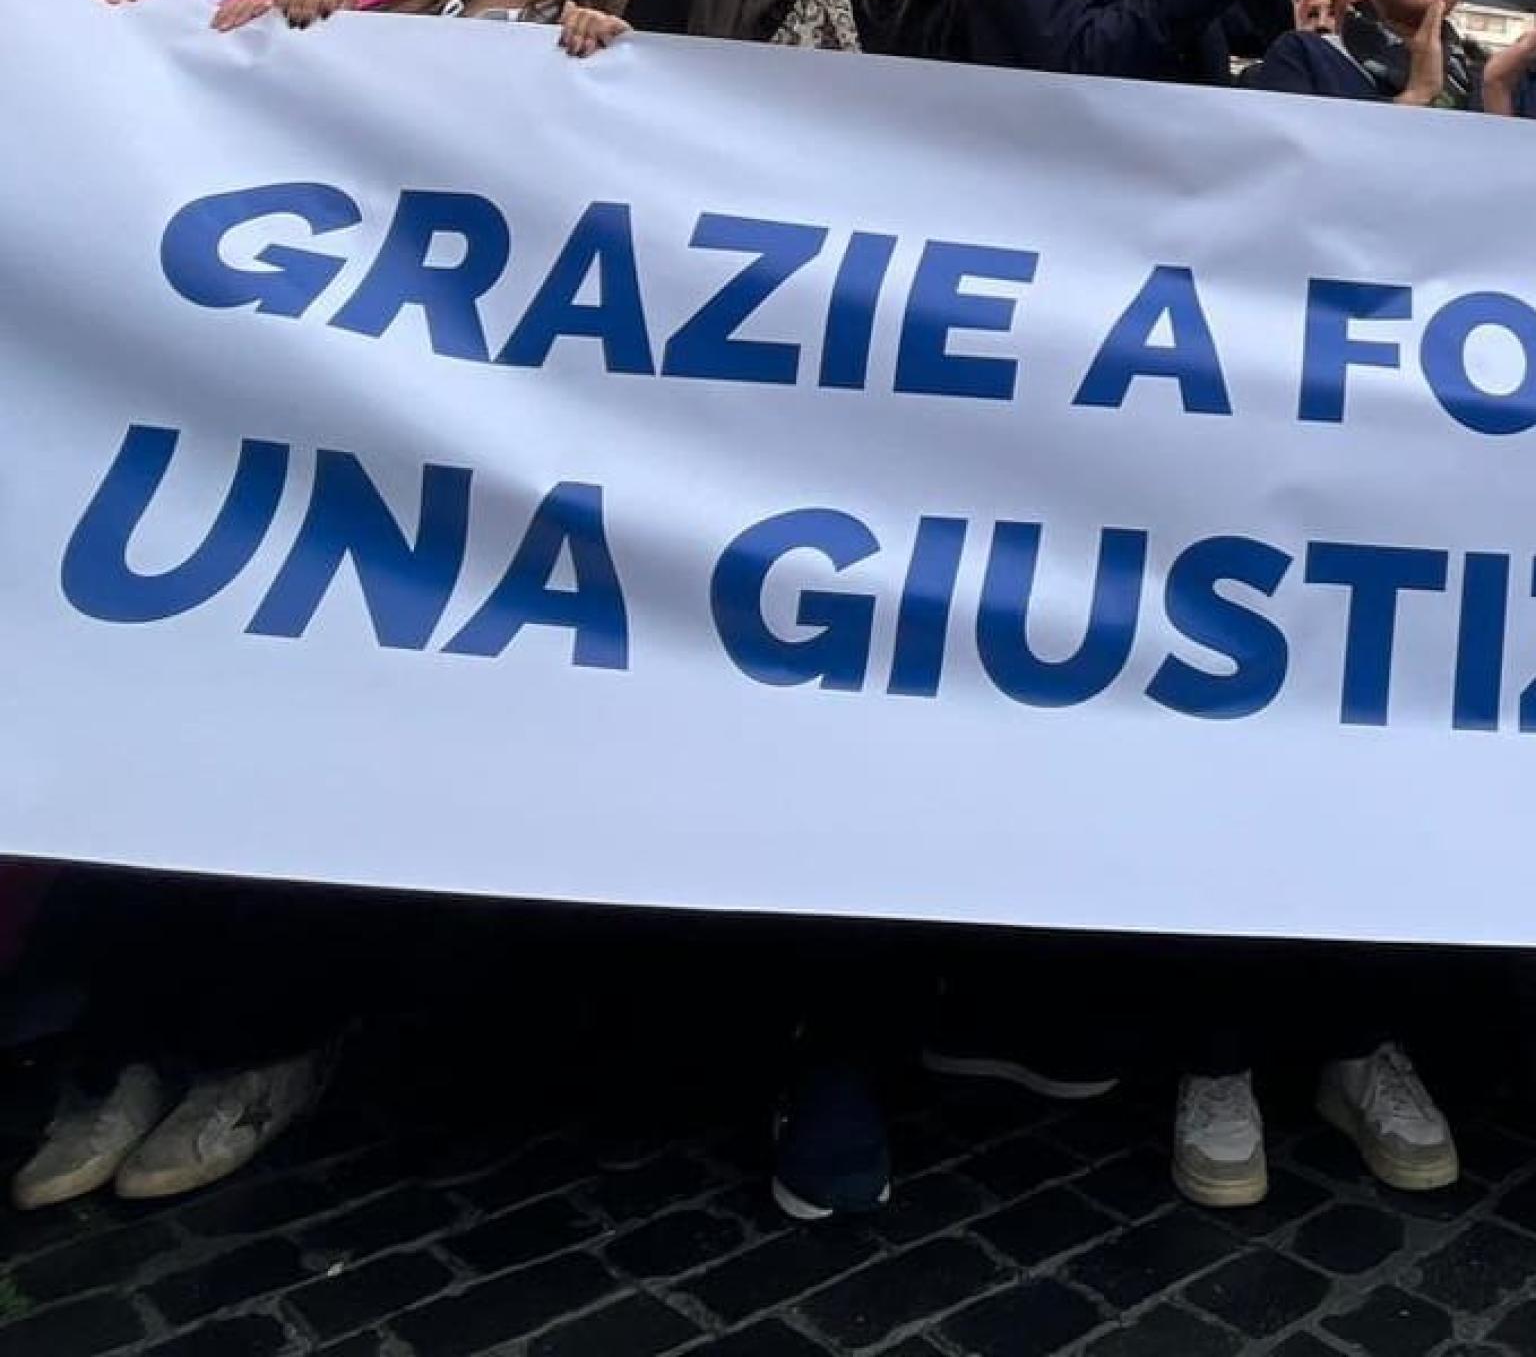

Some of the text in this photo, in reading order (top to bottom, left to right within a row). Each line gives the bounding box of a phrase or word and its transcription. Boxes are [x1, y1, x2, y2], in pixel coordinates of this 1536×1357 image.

[162, 184, 1036, 401] GRAZIE
[1076, 266, 1232, 416] A
[61, 424, 630, 669] UNA
